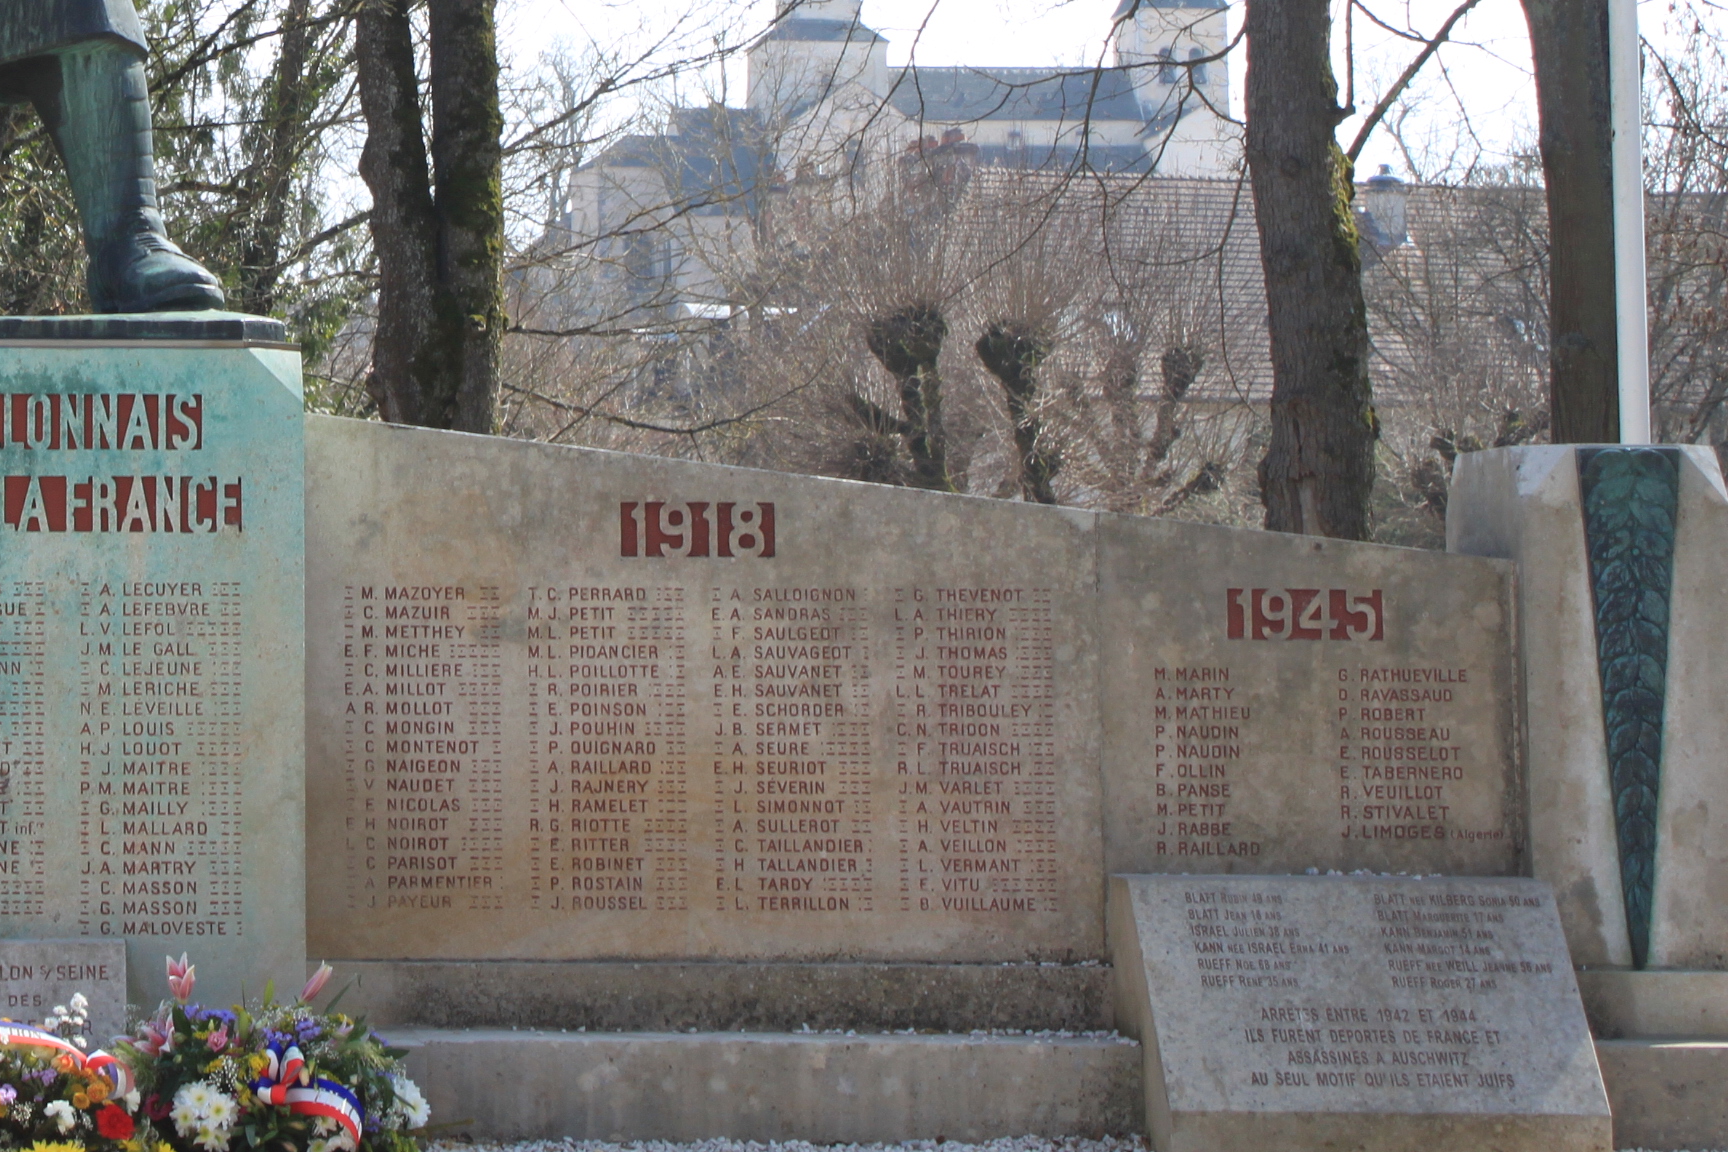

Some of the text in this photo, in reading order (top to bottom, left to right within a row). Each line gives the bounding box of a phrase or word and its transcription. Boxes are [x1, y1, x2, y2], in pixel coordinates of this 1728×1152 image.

[71, 475, 241, 532] FRANCE
[626, 500, 769, 557] 1918
[122, 582, 202, 596] LECUYER
[384, 587, 465, 600] MAZOYER
[568, 587, 646, 601] PERRARD
[935, 588, 1023, 602] THEVENOT
[122, 602, 209, 616] LEFEBVRE
[568, 607, 614, 620] PETIT
[1233, 588, 1379, 641] 1945
[385, 644, 439, 657] MICHE
[569, 645, 658, 659] PIDANCIER
[753, 646, 851, 659] SAUVAGEOT
[936, 646, 1007, 659] THOMAS
[1359, 669, 1468, 683] RATHUEVILLE
[385, 683, 444, 695] MILLOT
[1175, 687, 1234, 700] MARTY
[1360, 689, 1453, 702] RAVASSAUD
[937, 703, 1032, 717] TRIBOULEY
[1175, 706, 1250, 719] MATHIEU
[1360, 708, 1425, 721] ROBERT
[122, 722, 174, 736] LOUIS
[386, 740, 479, 753] MONTENOT
[1361, 746, 1462, 761] ROUSSELOT
[1362, 766, 1463, 780] TABERNERO
[1177, 783, 1230, 797] PANSE
[1362, 785, 1442, 799] VEUILLOT
[122, 802, 187, 815] MAILLY
[571, 799, 648, 812] RAMELET
[756, 800, 844, 813] SIMONNOT
[1362, 805, 1450, 820] STIVALET
[1361, 825, 1446, 839] LIMOGES
[757, 839, 863, 852] TAILLANDIER
[1177, 842, 1261, 856] RAILLARD
[387, 856, 457, 870] PARISOT
[571, 857, 644, 871] ROBINET
[940, 859, 1020, 872] VERMANT
[122, 881, 197, 894] MASSON
[57, 965, 109, 980] SEINE
[1326, 1008, 1368, 1022] ENTRE
[1377, 1008, 1409, 1022] 1942
[1418, 1009, 1433, 1023] ET
[1443, 1008, 1477, 1022] 1944
[1245, 1028, 1500, 1045] ILS FURENT DEPORTES DE FRANCE ET
[1288, 1050, 1369, 1064] ASSASSINES
[1392, 1052, 1469, 1065] AUSCHWITZ
[1251, 1072, 1268, 1085] AU
[1275, 1072, 1309, 1086] SEUL
[1316, 1073, 1355, 1086] MOTIF
[1417, 1073, 1469, 1087] ETAIENT
[1478, 1073, 1515, 1089] JUIFS
